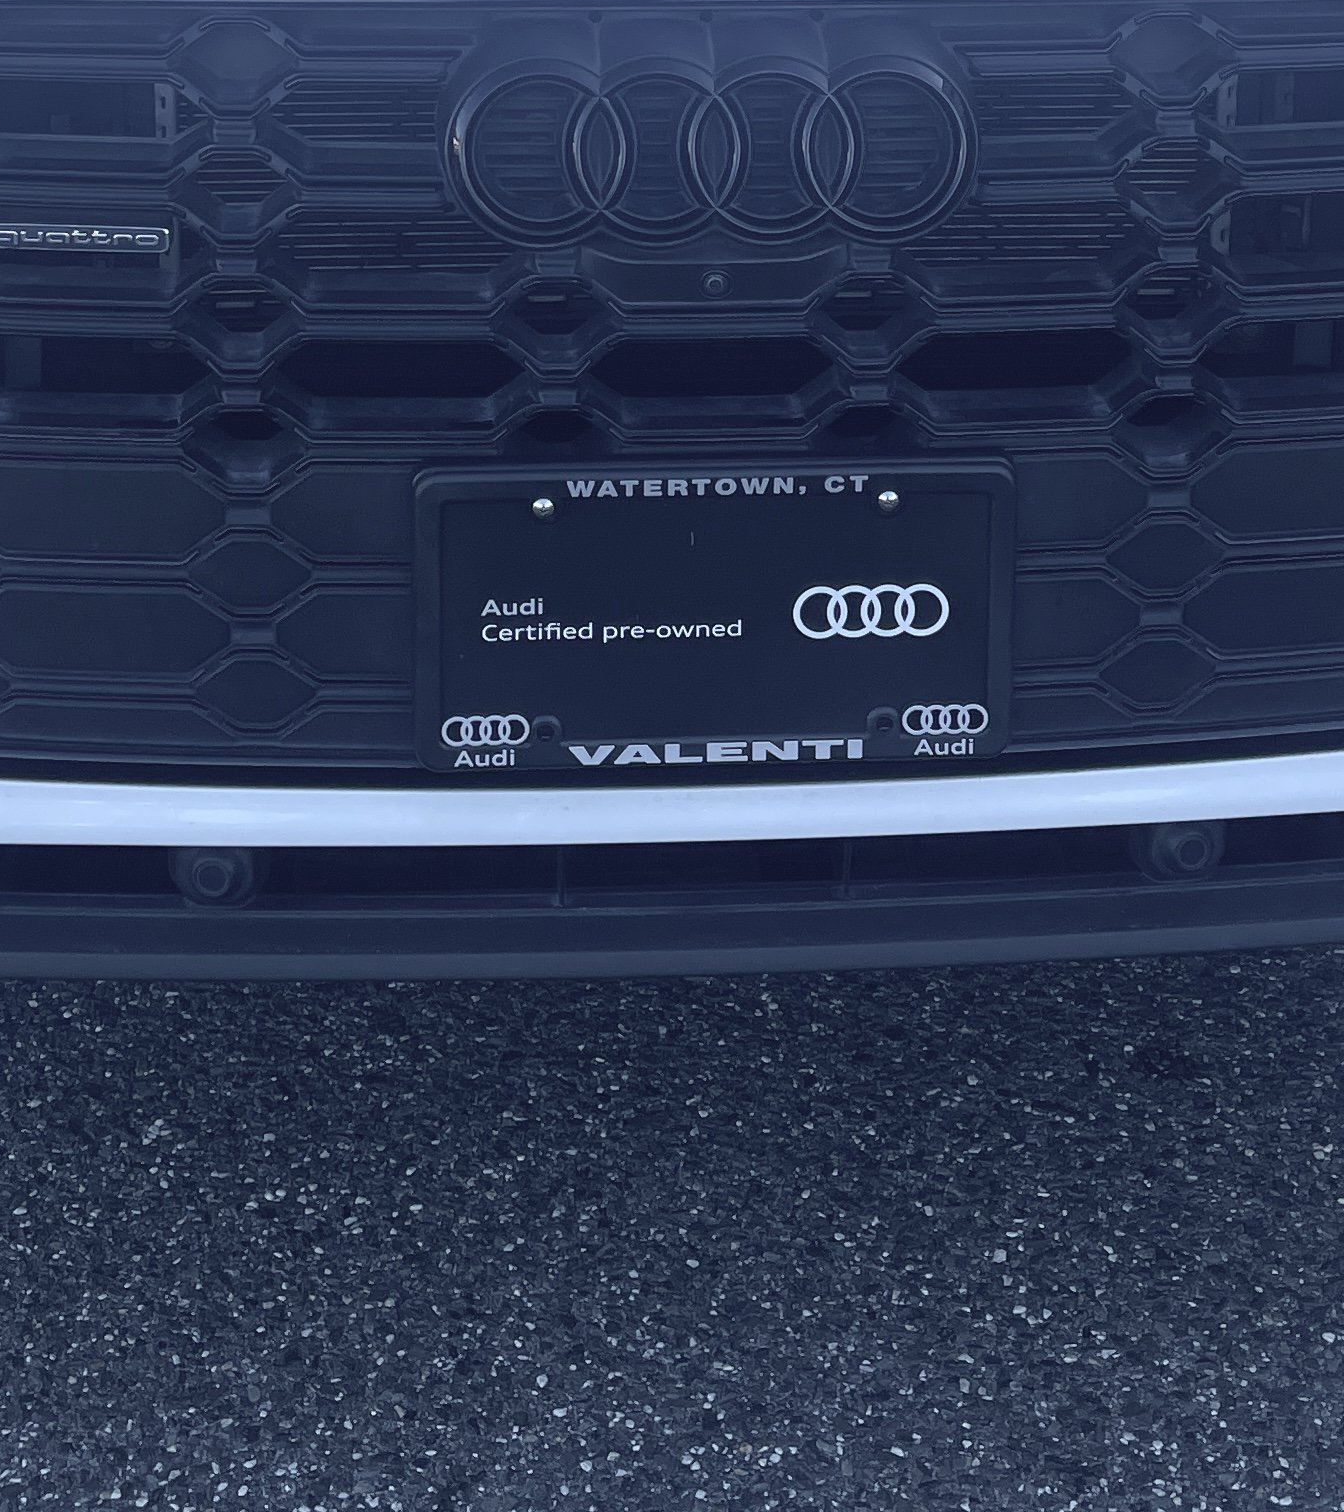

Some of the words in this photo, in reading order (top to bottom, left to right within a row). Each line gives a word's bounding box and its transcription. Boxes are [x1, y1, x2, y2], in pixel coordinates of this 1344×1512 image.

[566, 477, 807, 499] WATERTOWN,
[823, 474, 869, 494] CT
[481, 598, 544, 617] Audi
[481, 621, 594, 642] Certified
[602, 619, 743, 644] pre-owned
[567, 739, 864, 767] VALENTI
[913, 737, 976, 757] Audi
[453, 749, 516, 768] Audi
